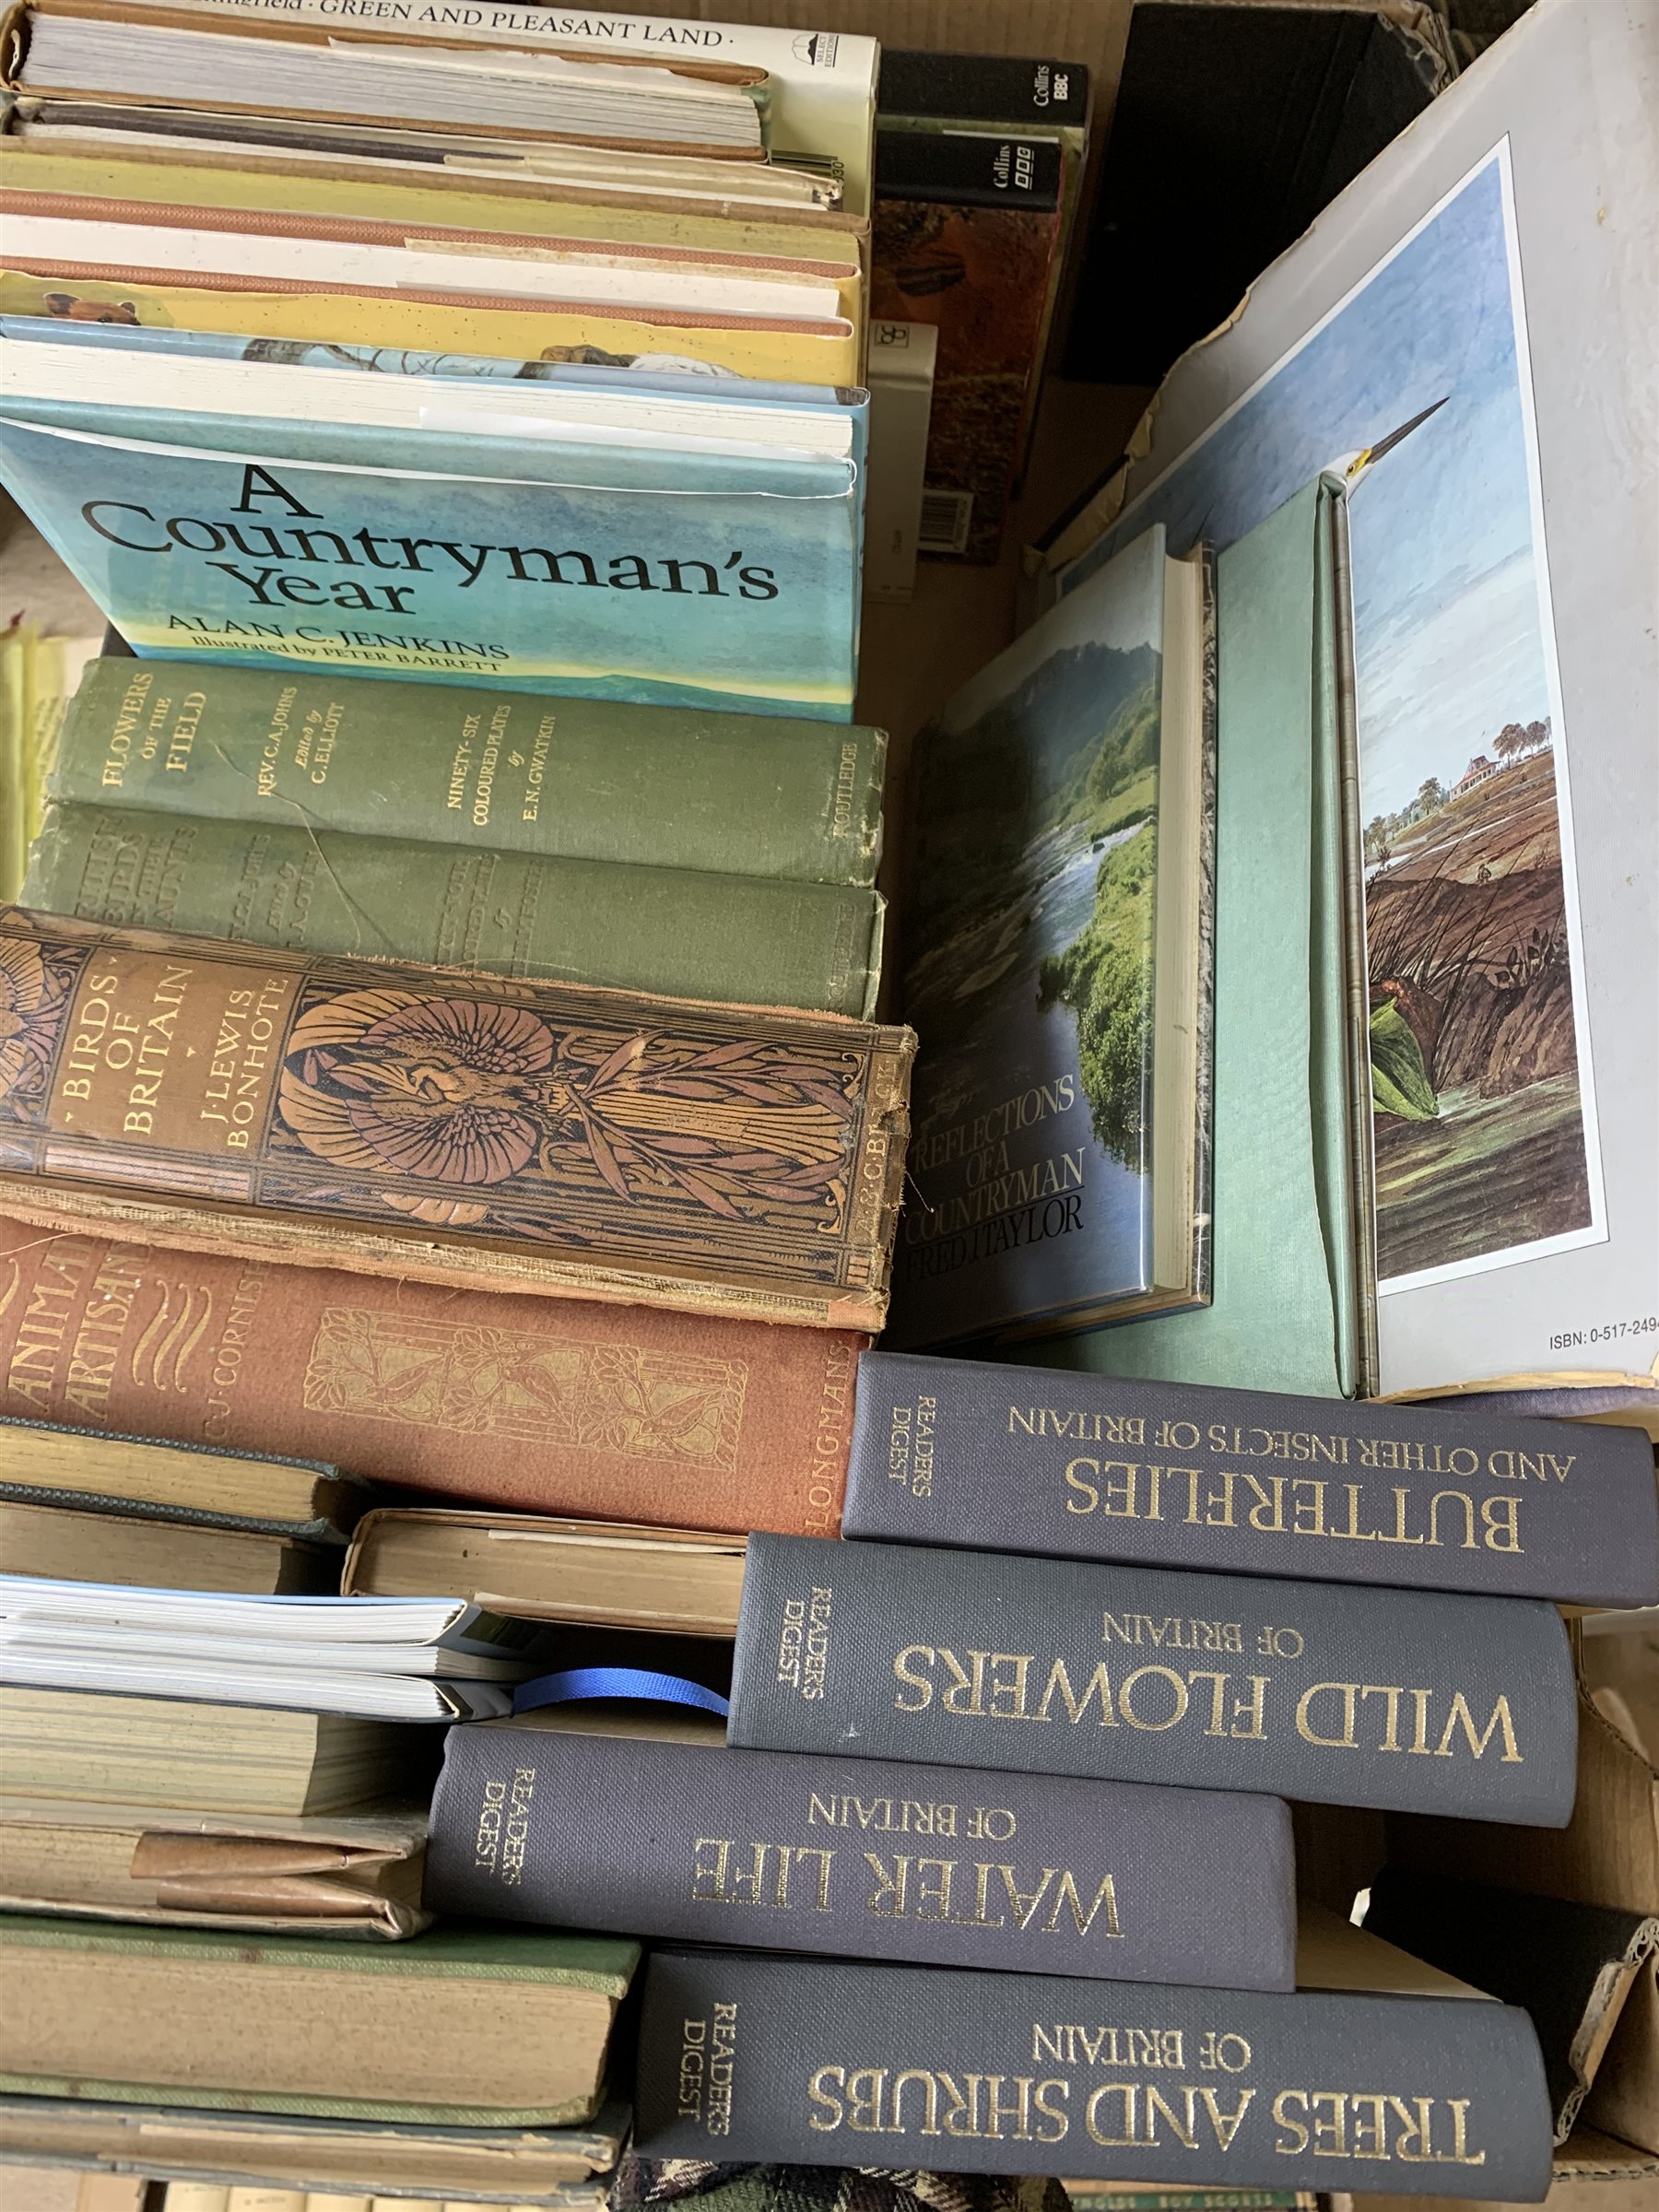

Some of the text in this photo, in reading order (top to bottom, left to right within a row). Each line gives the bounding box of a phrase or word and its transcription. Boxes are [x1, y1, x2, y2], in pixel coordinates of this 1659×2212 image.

[320, 0, 413, 19] GREEN
[418, 6, 482, 25] AND
[491, 12, 636, 40] PLEASANT
[644, 26, 723, 47] LAND
[817, 35, 828, 63] SELECT
[1033, 65, 1050, 107] Collins
[1053, 74, 1069, 100] BBC
[994, 145, 1011, 188] Collins
[1015, 146, 1033, 190] BBC
[229, 464, 324, 519] A
[81, 500, 780, 601] Countryman's
[206, 560, 417, 615] Year
[167, 614, 285, 639] ALAN
[341, 630, 510, 660] JENKINS
[191, 635, 501, 673] Illustrated by PETER BARRETT
[102, 672, 154, 788] FLOWERS
[149, 697, 172, 731] THE
[166, 691, 206, 772] FIELD
[295, 709, 323, 770] Edited by
[140, 736, 159, 760] OF
[474, 704, 511, 826] COLOURED PLATES
[508, 749, 524, 768] by
[832, 742, 858, 839] ROUTLEDGE
[154, 827, 197, 927] AUNTS
[63, 974, 118, 1100] BIRDS
[105, 1012, 140, 1070] OF
[124, 965, 194, 1135] BRITAIN
[228, 978, 288, 1148] BONHOTE
[913, 1074, 1076, 1174] REFLECTIONS
[967, 1140, 1010, 1188] OF A
[905, 1147, 1086, 1245] COUNTRYMAN
[981, 1194, 1085, 1257] TAYLOR
[1550, 1331, 1587, 1349] ISBN:
[888, 1406, 912, 1486] DIGEST
[1006, 1406, 1577, 1484] AND OTHER INSECTS OF BRITAIN
[1065, 1457, 1525, 1554] BUTTERFLIES
[776, 1599, 806, 1689] DIGEST
[1101, 1611, 1305, 1660] OF BRITAIN
[892, 1644, 1524, 1763] WILD FLOWERS
[475, 1781, 506, 1877] DIGEST
[806, 1793, 1017, 1841] OF BRITAIN
[691, 1838, 1125, 1938] WATER LIFE
[677, 2018, 706, 2123] DIGEST
[1031, 2023, 1252, 2074] OF BRITAIN
[807, 2065, 1486, 2166] TREES AND SHRUBS
[1159, 2195, 1192, 2209] BOY
